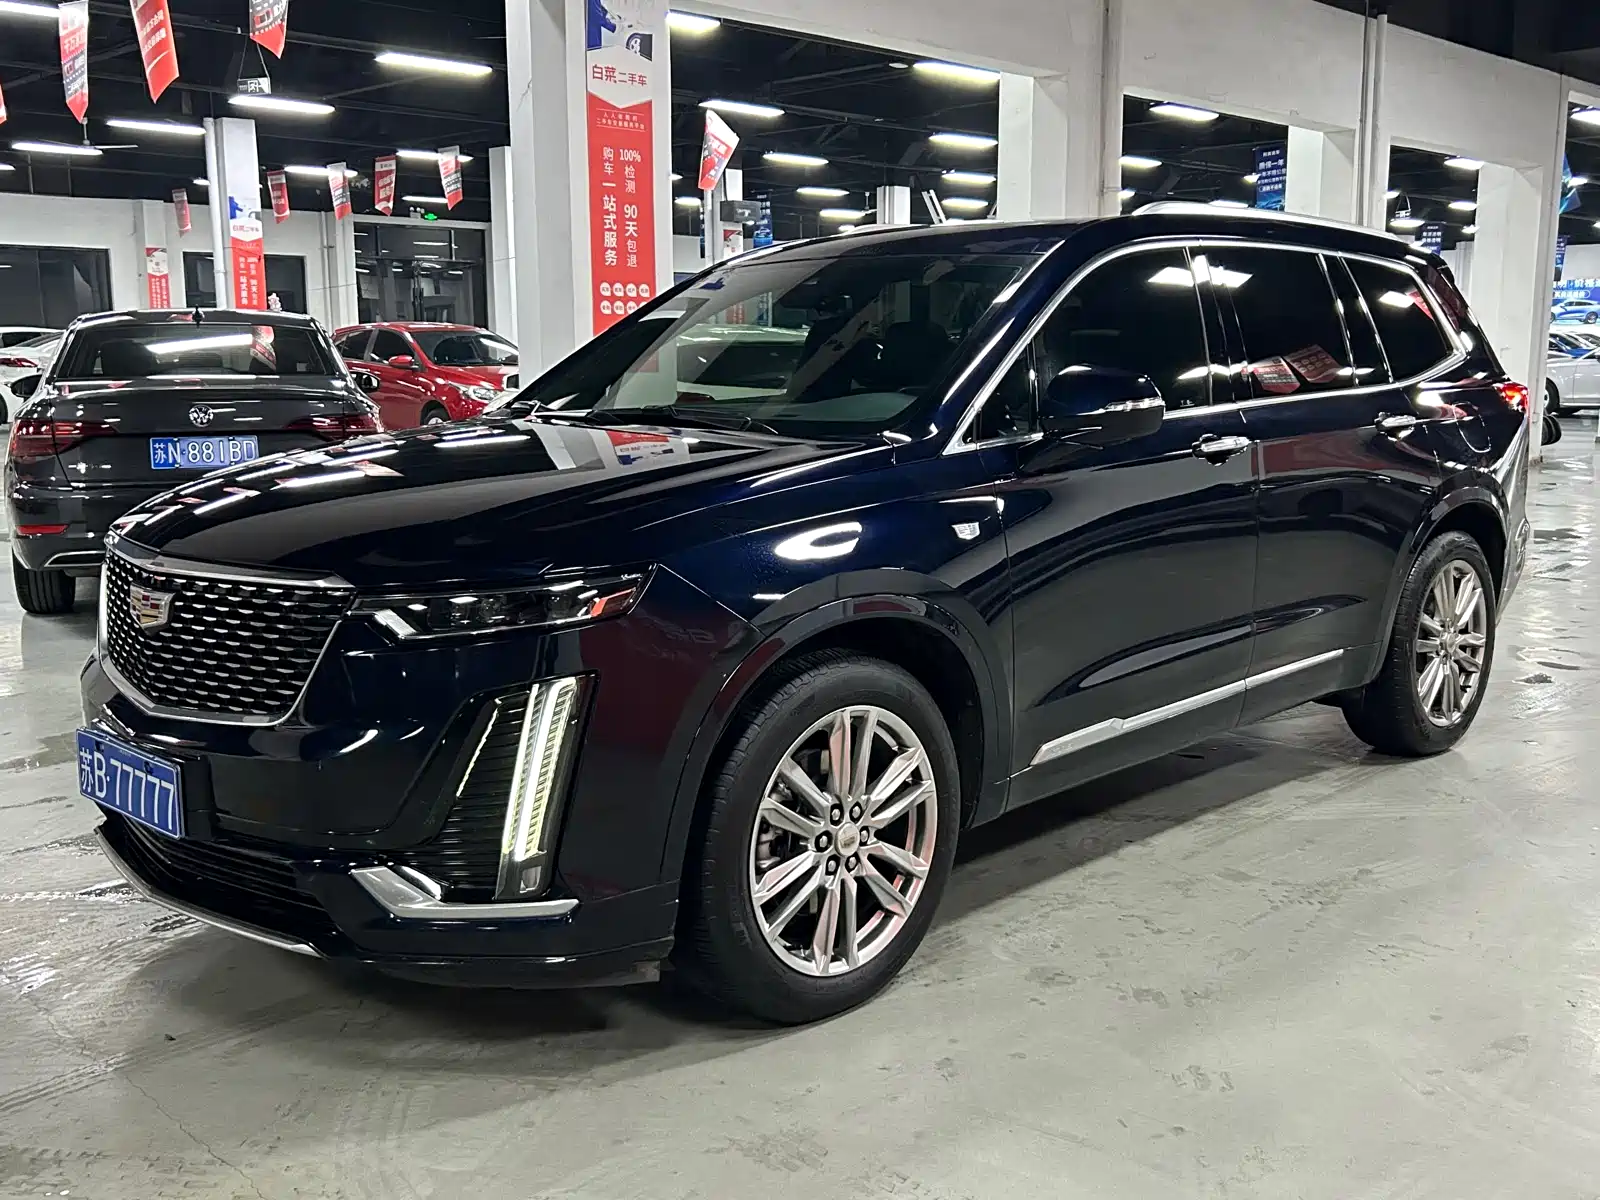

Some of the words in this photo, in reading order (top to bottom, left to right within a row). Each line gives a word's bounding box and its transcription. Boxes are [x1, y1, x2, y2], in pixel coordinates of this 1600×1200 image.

[592, 64, 648, 86] 白菜二手车
[602, 146, 617, 266] 购车一站式服务
[79, 746, 175, 831] 苏B·77777
